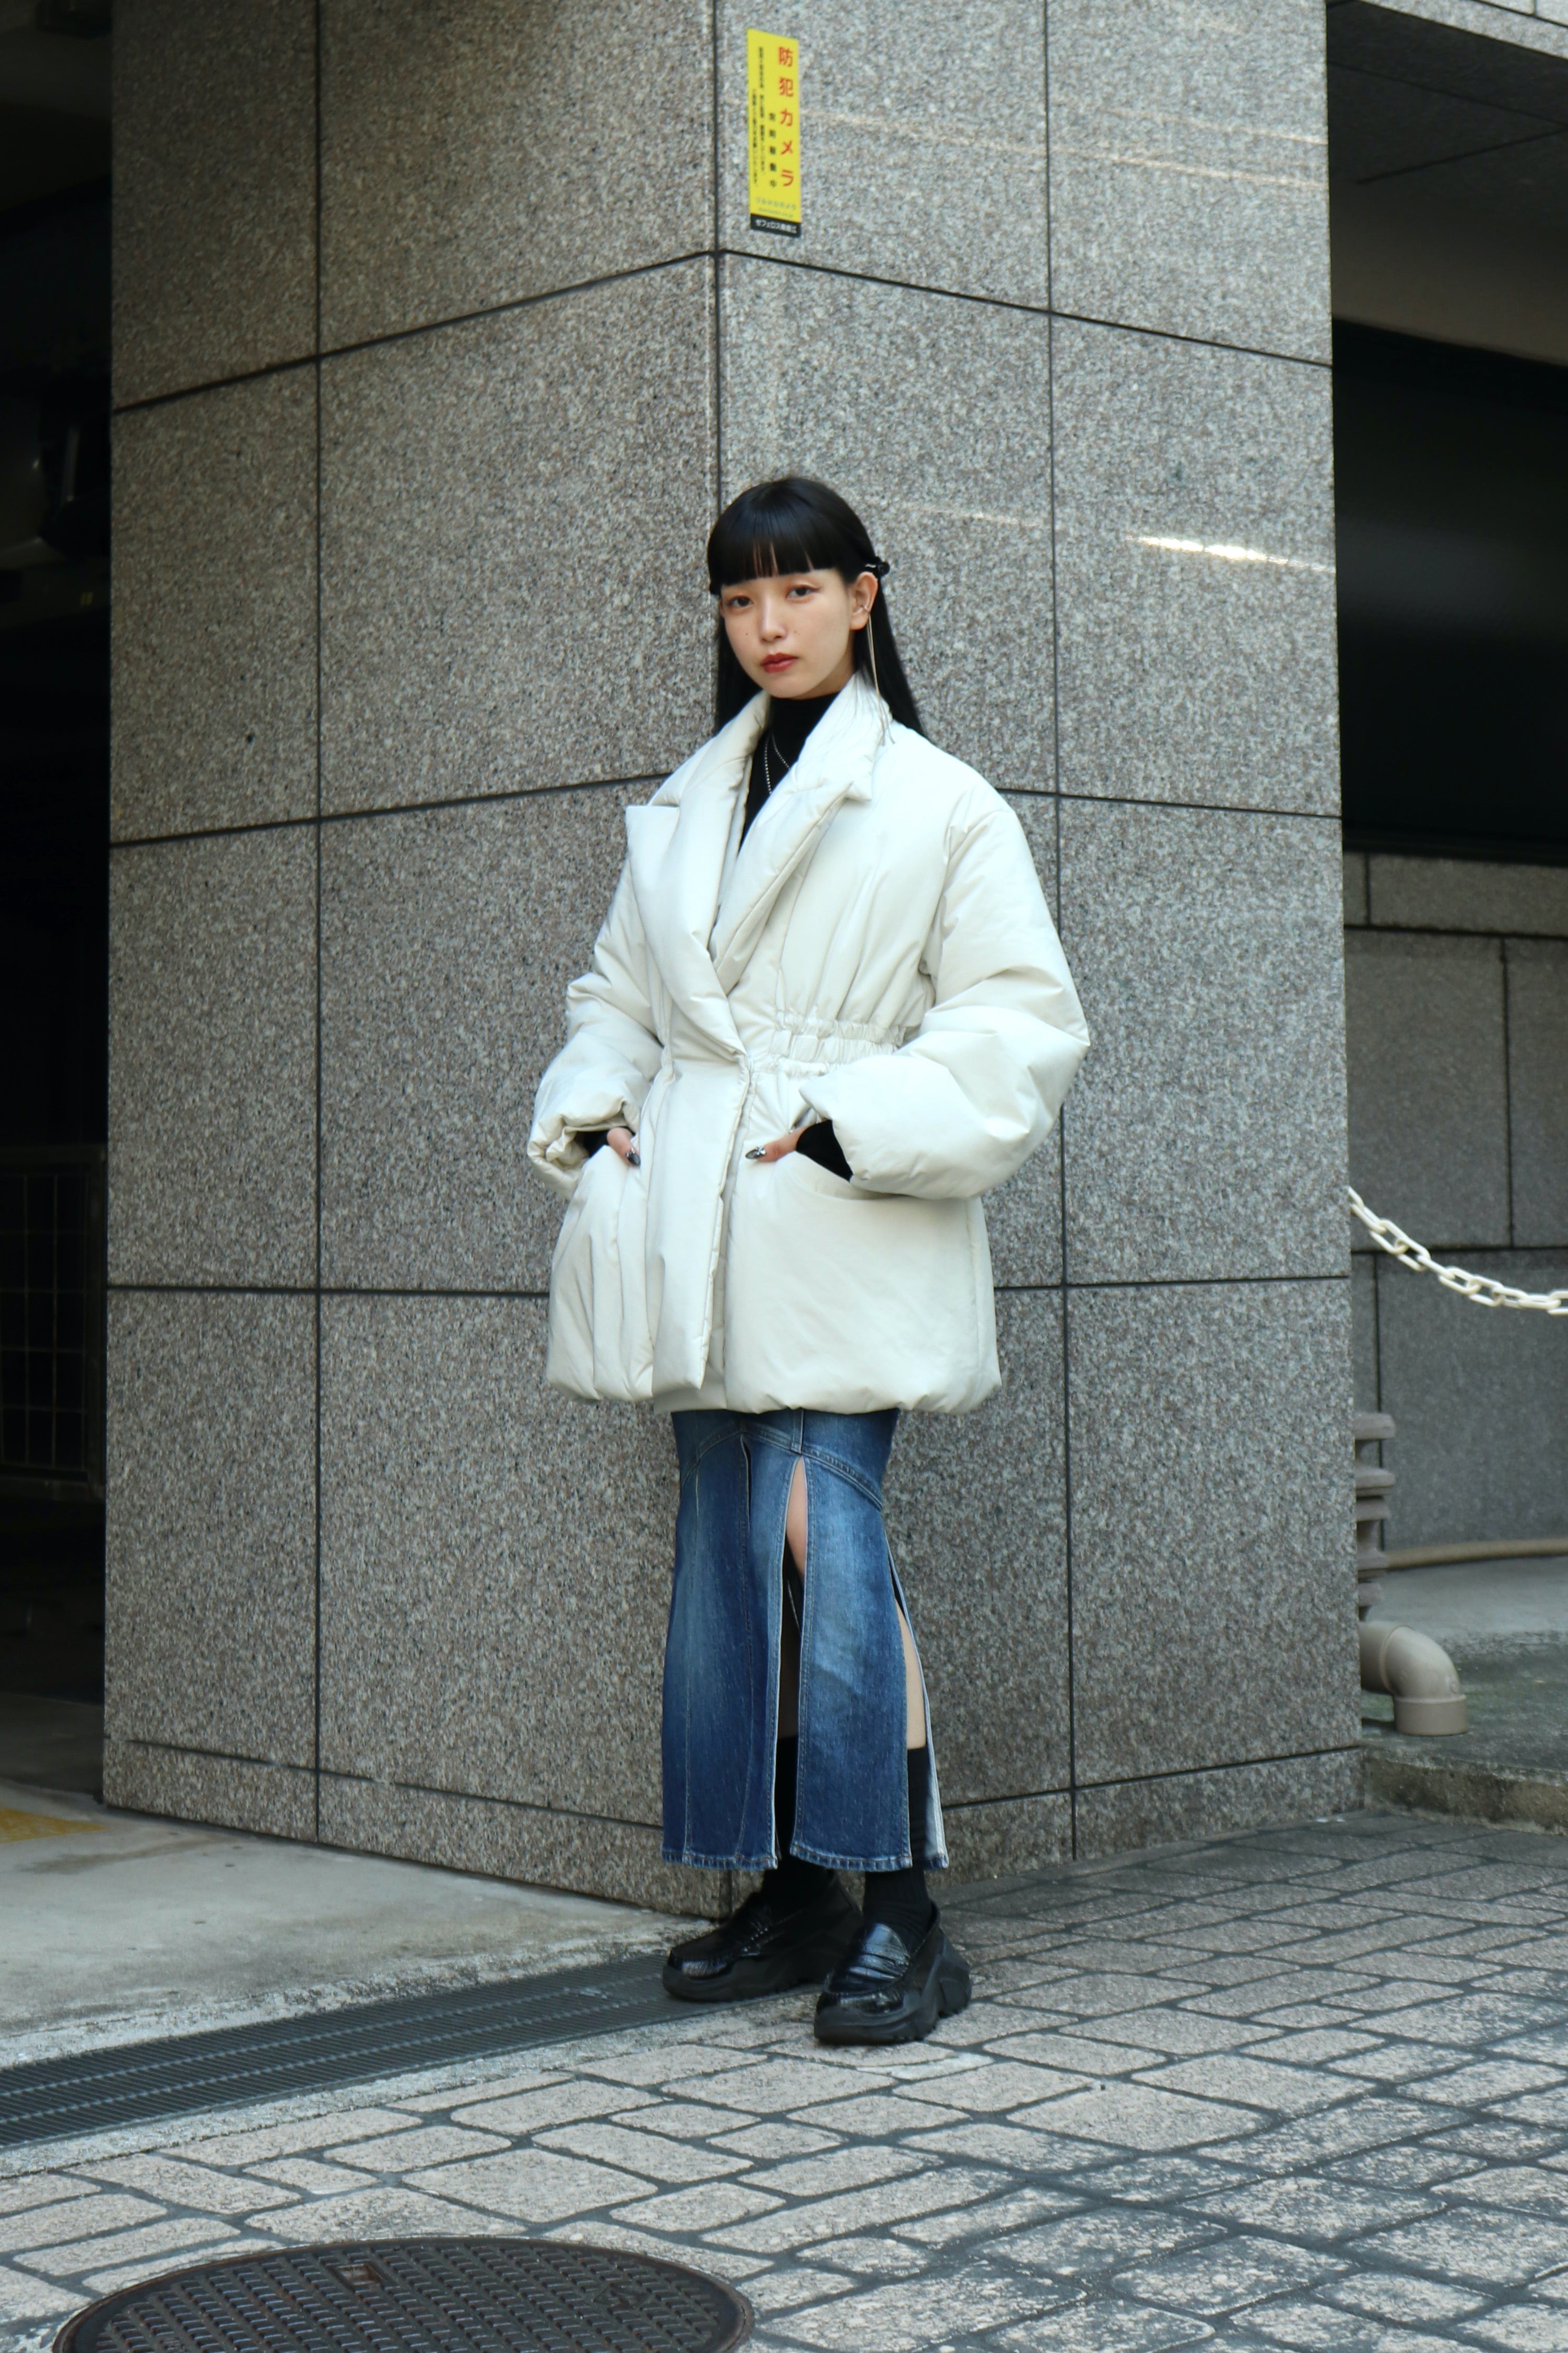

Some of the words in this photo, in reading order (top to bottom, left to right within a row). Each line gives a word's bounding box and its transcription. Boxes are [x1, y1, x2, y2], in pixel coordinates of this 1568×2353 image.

[778, 46, 794, 187] 防犯カメラ
